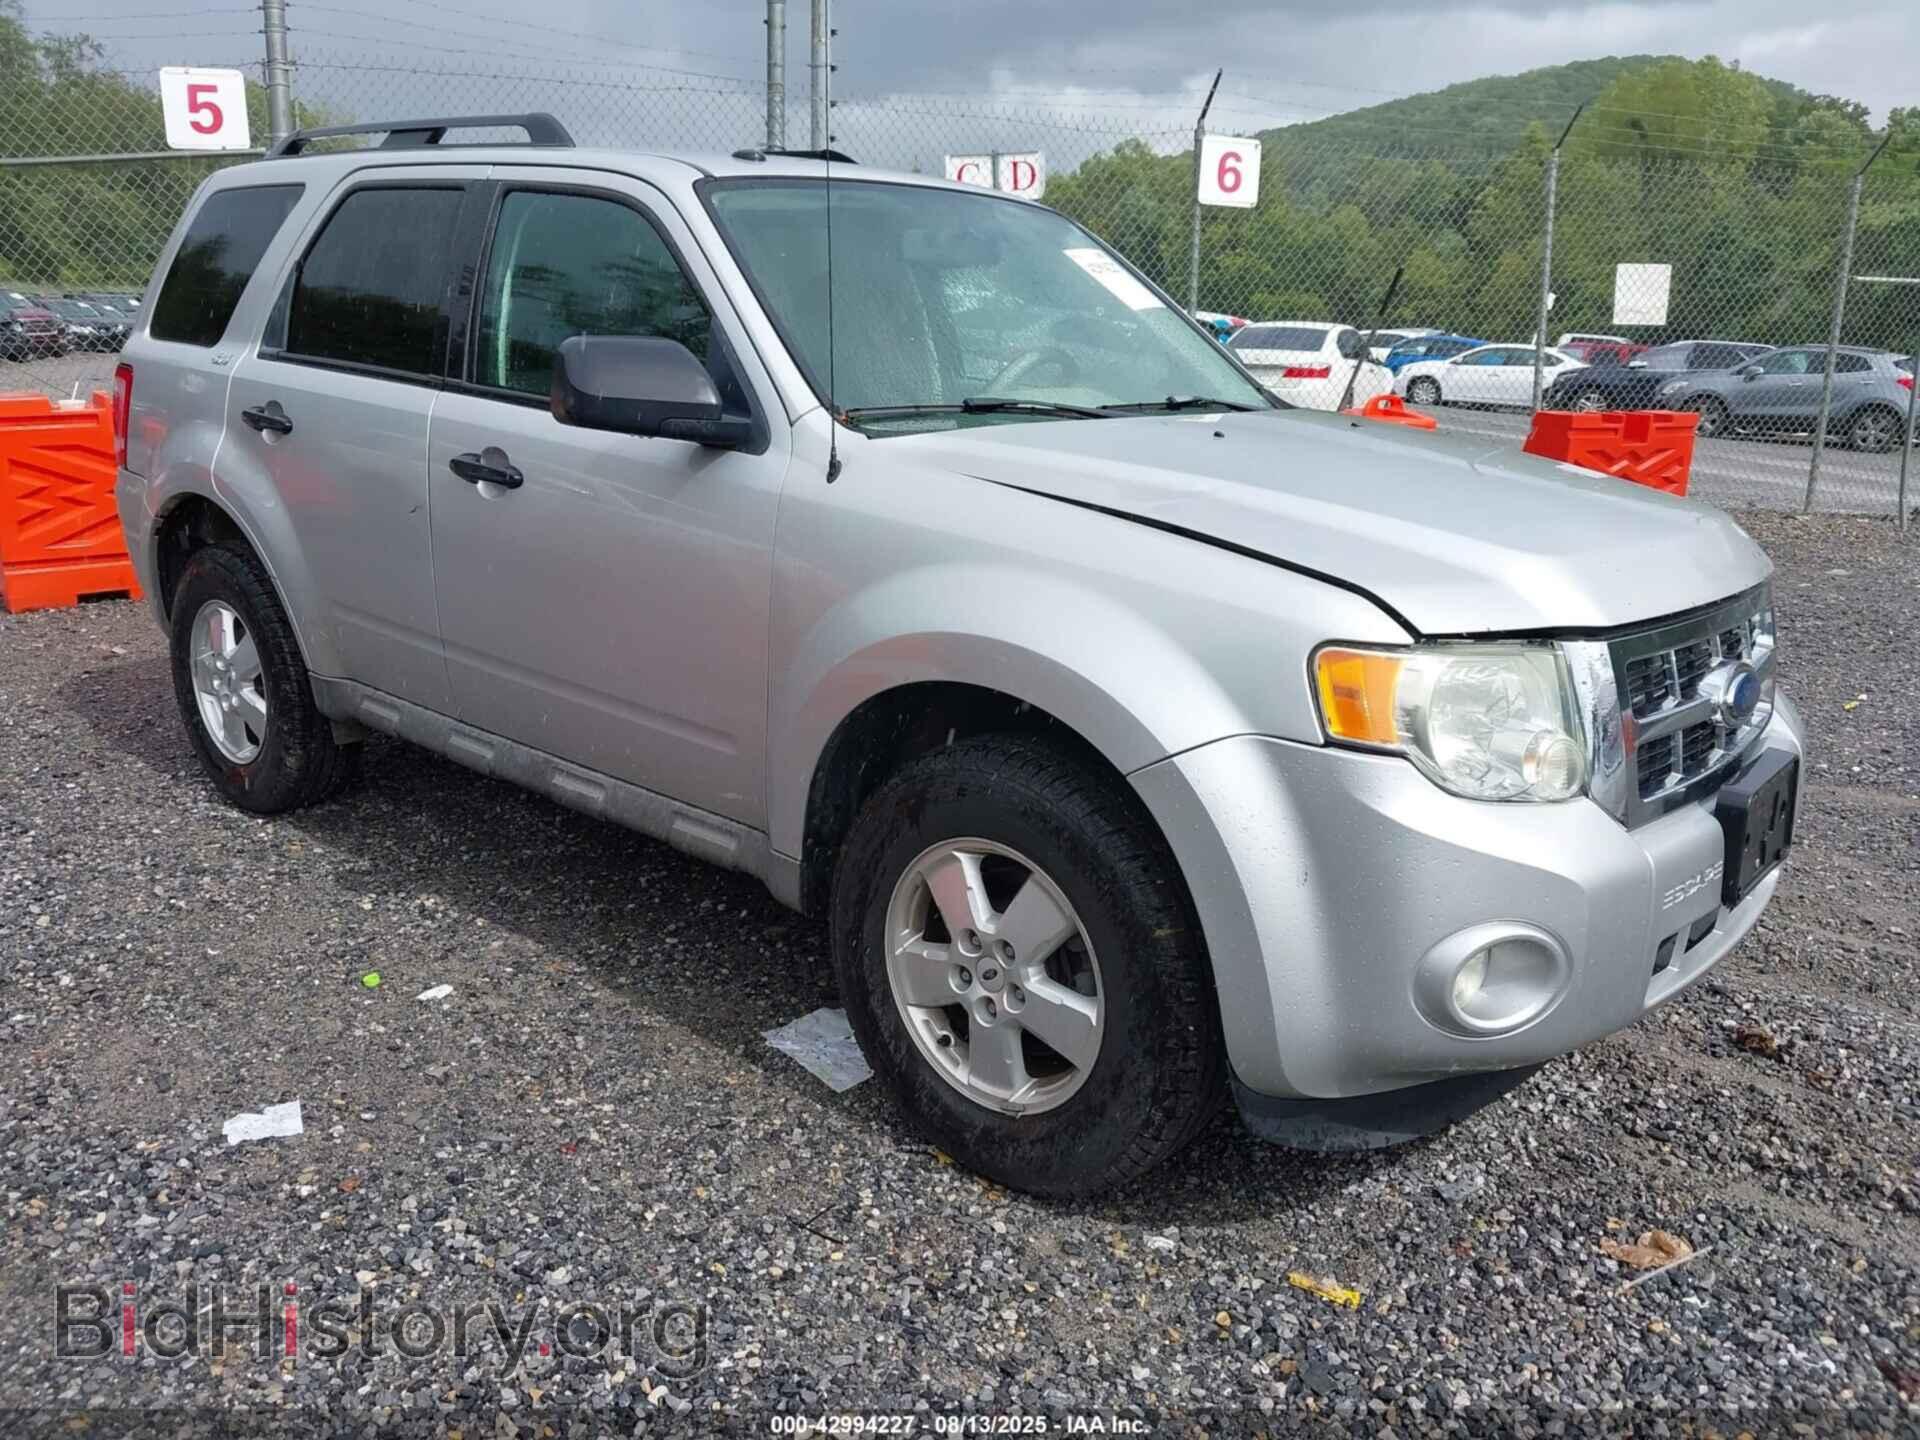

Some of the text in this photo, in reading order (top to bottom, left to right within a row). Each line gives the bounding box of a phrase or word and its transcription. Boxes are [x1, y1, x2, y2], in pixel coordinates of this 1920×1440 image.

[187, 84, 223, 134] 5
[957, 163, 980, 183] C
[1011, 160, 1036, 191] D
[1218, 151, 1242, 193] 6
[1663, 860, 1723, 910] ESCAPE
